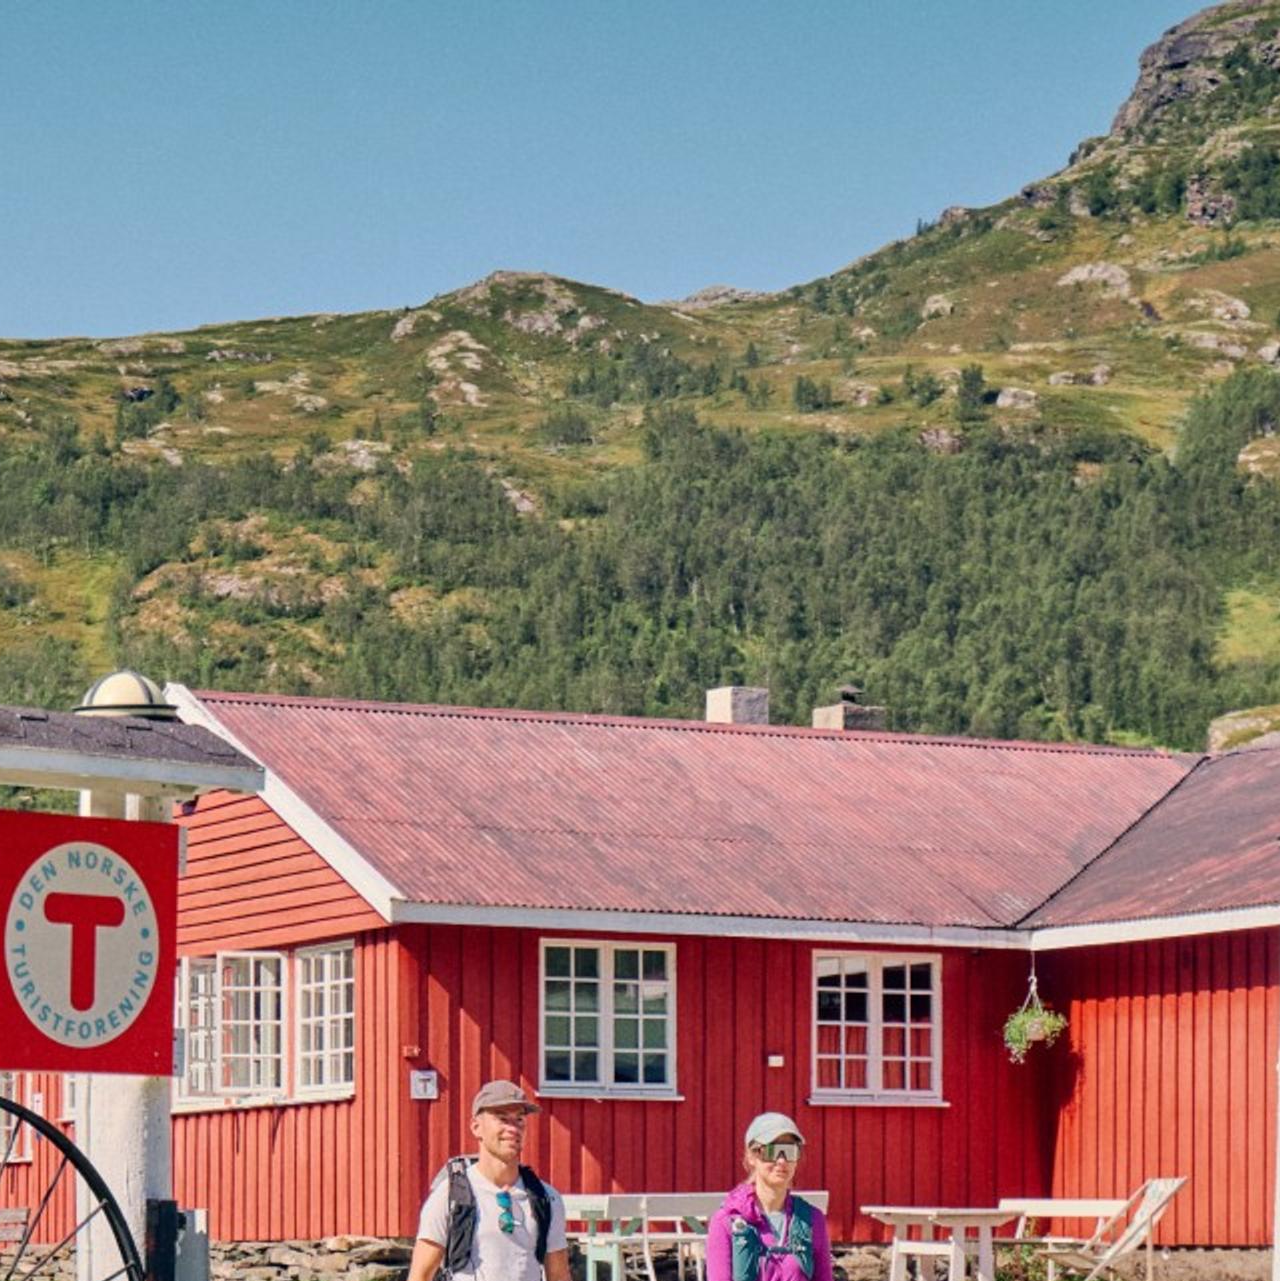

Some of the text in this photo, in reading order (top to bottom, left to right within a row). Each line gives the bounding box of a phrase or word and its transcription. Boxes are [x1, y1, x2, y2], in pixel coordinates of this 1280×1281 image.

[19, 851, 147, 916] DEN NORSKE
[12, 944, 153, 1039] TURISTFORENING
[44, 892, 125, 1012] T
